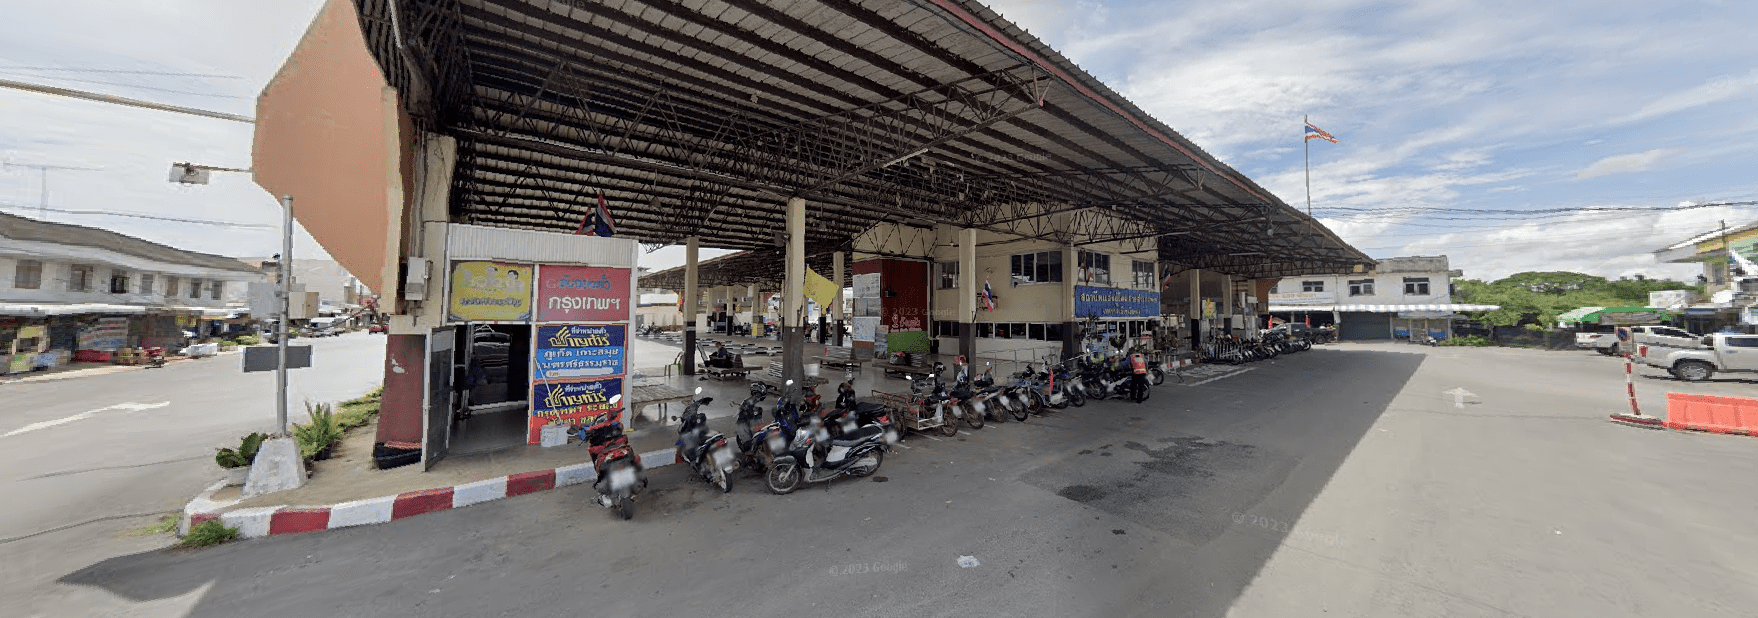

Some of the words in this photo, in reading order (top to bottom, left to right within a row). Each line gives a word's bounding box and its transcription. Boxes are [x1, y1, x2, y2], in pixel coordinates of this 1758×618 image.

[548, 296, 621, 314] กรุงเทพฯ
[543, 348, 573, 360] ภูเก็ต
[575, 348, 619, 358] เกาะสมุย
[541, 359, 619, 369] นครศรีธรรมราช
